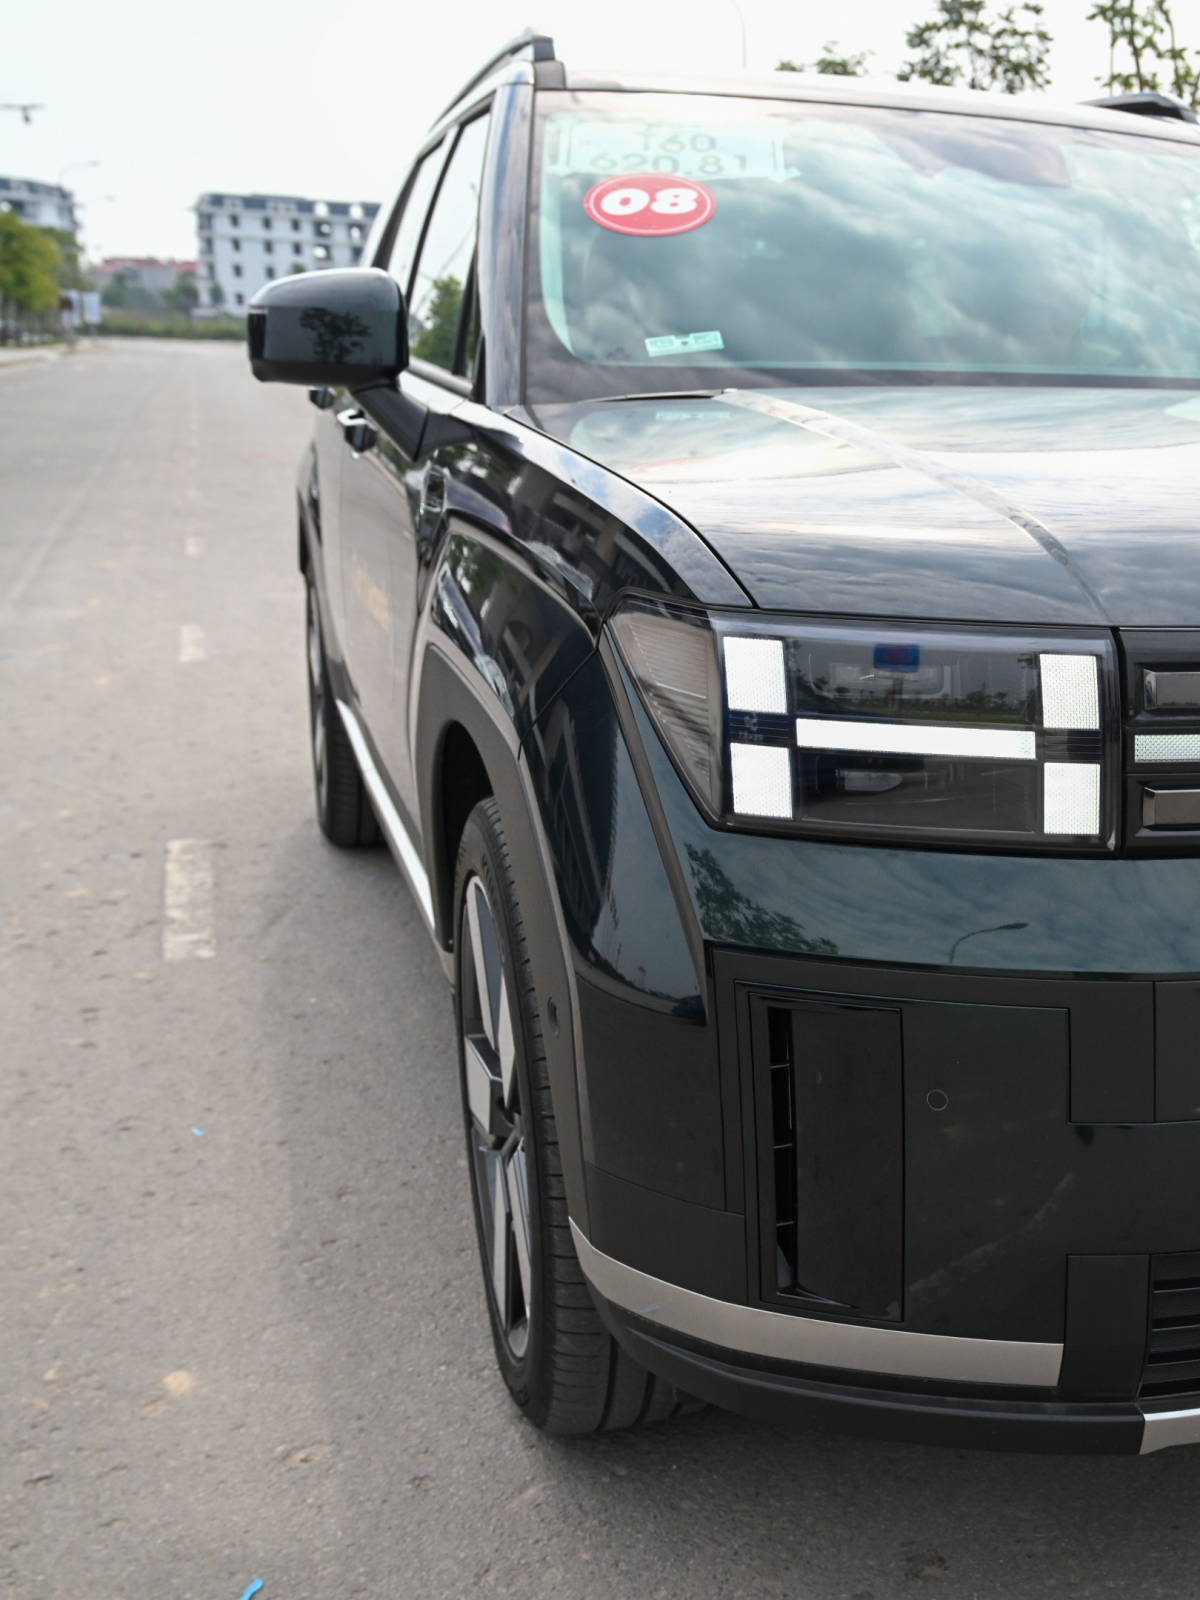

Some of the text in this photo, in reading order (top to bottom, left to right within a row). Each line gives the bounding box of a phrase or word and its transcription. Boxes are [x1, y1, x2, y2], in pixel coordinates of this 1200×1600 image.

[636, 132, 716, 153] T60
[589, 152, 748, 175] 620.81
[600, 188, 699, 215] 08
